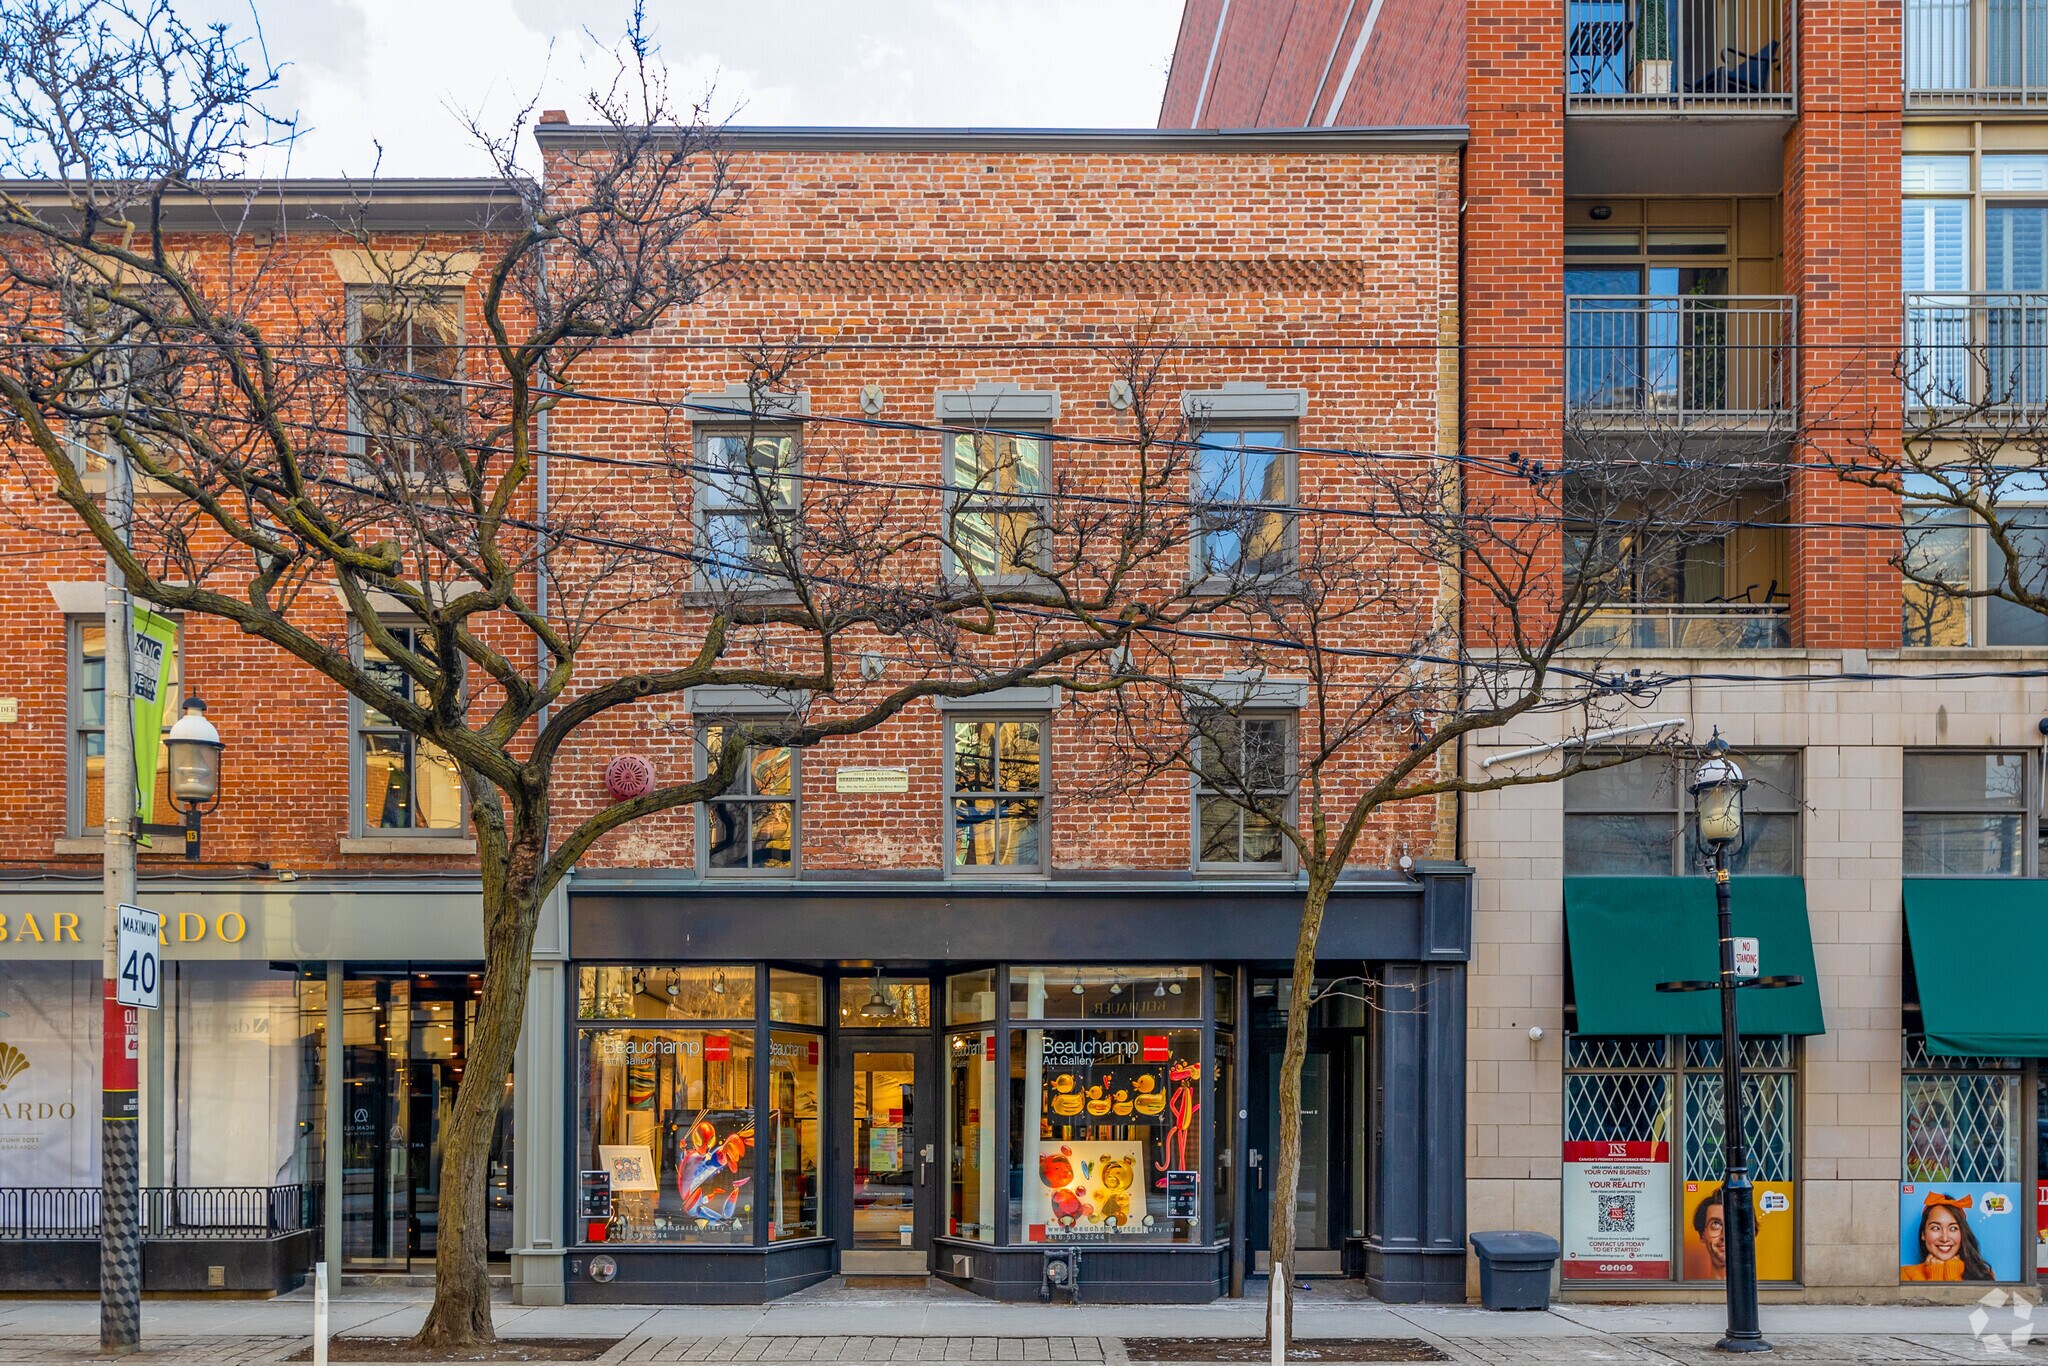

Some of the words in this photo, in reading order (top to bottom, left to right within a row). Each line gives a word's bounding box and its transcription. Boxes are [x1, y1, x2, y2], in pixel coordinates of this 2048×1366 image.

[122, 916, 157, 938] MAXIMUM
[1742, 942, 1751, 951] NO
[1736, 953, 1758, 964] STANDING
[122, 949, 156, 994] 40
[603, 1036, 701, 1058] Beauchamp
[1042, 1036, 1139, 1058] Beauchamp
[624, 1056, 656, 1067] Gallery
[1043, 1056, 1057, 1065] Art
[1060, 1055, 1096, 1067] Gallery
